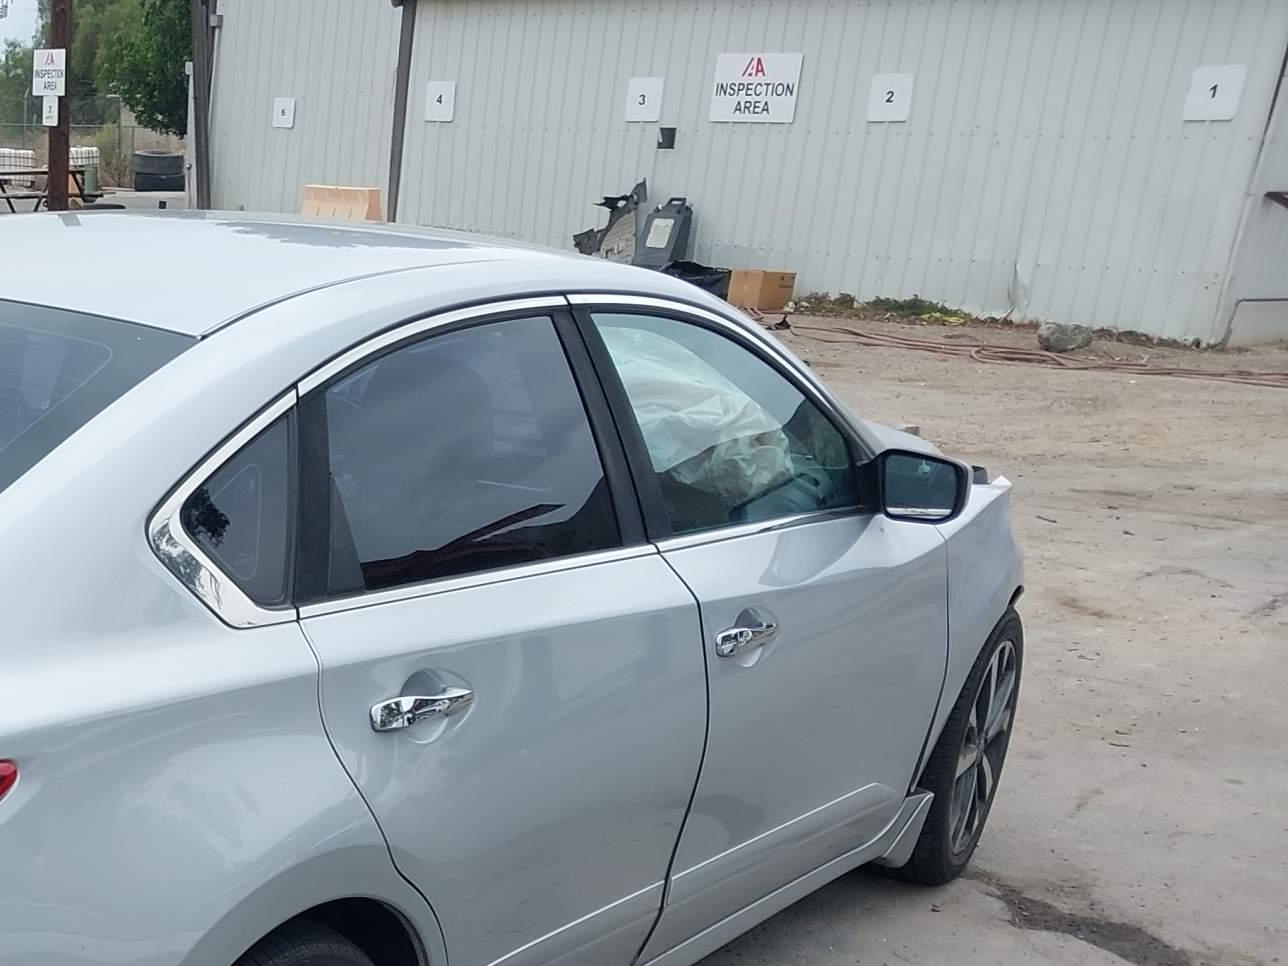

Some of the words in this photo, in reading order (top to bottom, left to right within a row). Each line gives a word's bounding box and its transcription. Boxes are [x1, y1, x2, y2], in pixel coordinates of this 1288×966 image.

[34, 69, 64, 79] INSPECTION
[43, 81, 57, 91] AREA
[715, 82, 795, 97] INSPECTION
[1208, 84, 1219, 99] 1
[436, 94, 444, 105] 4
[638, 94, 646, 106] 3
[885, 90, 895, 104] 2
[733, 100, 770, 115] AREA
